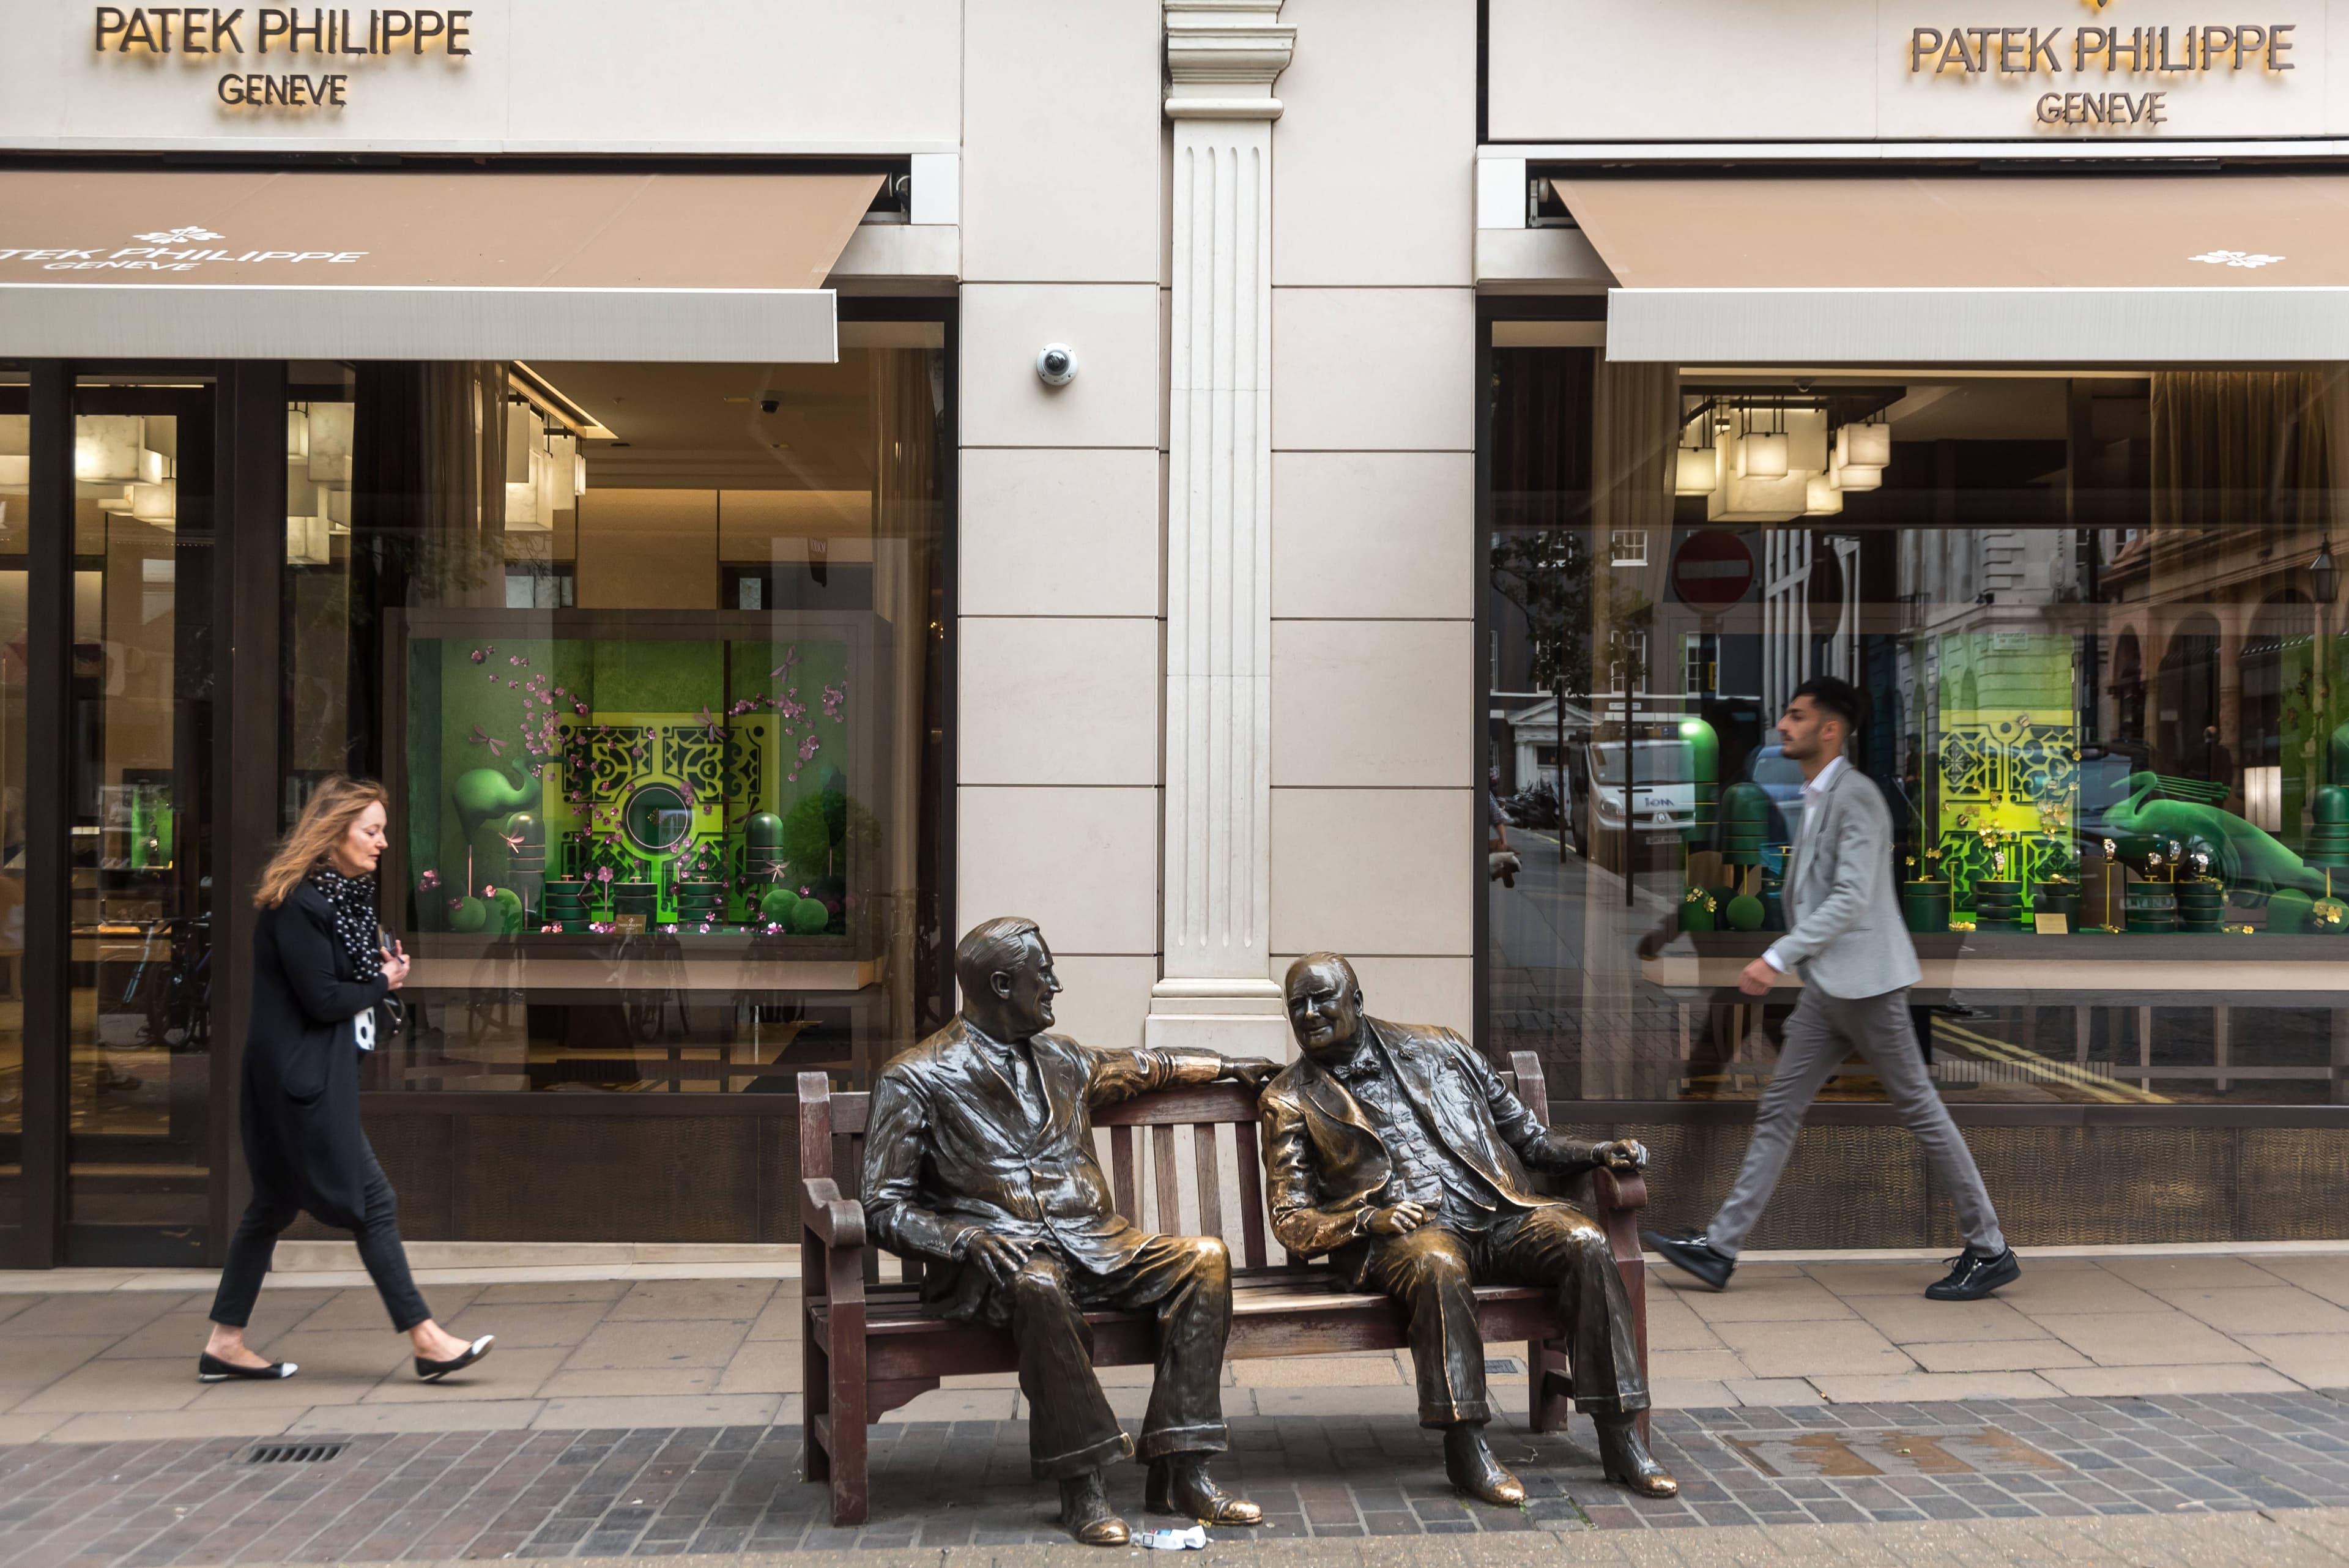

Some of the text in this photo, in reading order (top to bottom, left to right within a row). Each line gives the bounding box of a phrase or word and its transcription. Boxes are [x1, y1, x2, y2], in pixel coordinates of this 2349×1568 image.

[96, 7, 473, 56] PATEK PHILIPPE
[1912, 24, 2296, 73] PATEK PHILIPPE
[218, 74, 347, 106] GENEVE
[2036, 92, 2168, 124] GENEVE
[42, 261, 201, 270] GENEVE
[108, 247, 370, 262] PHILIPPE
